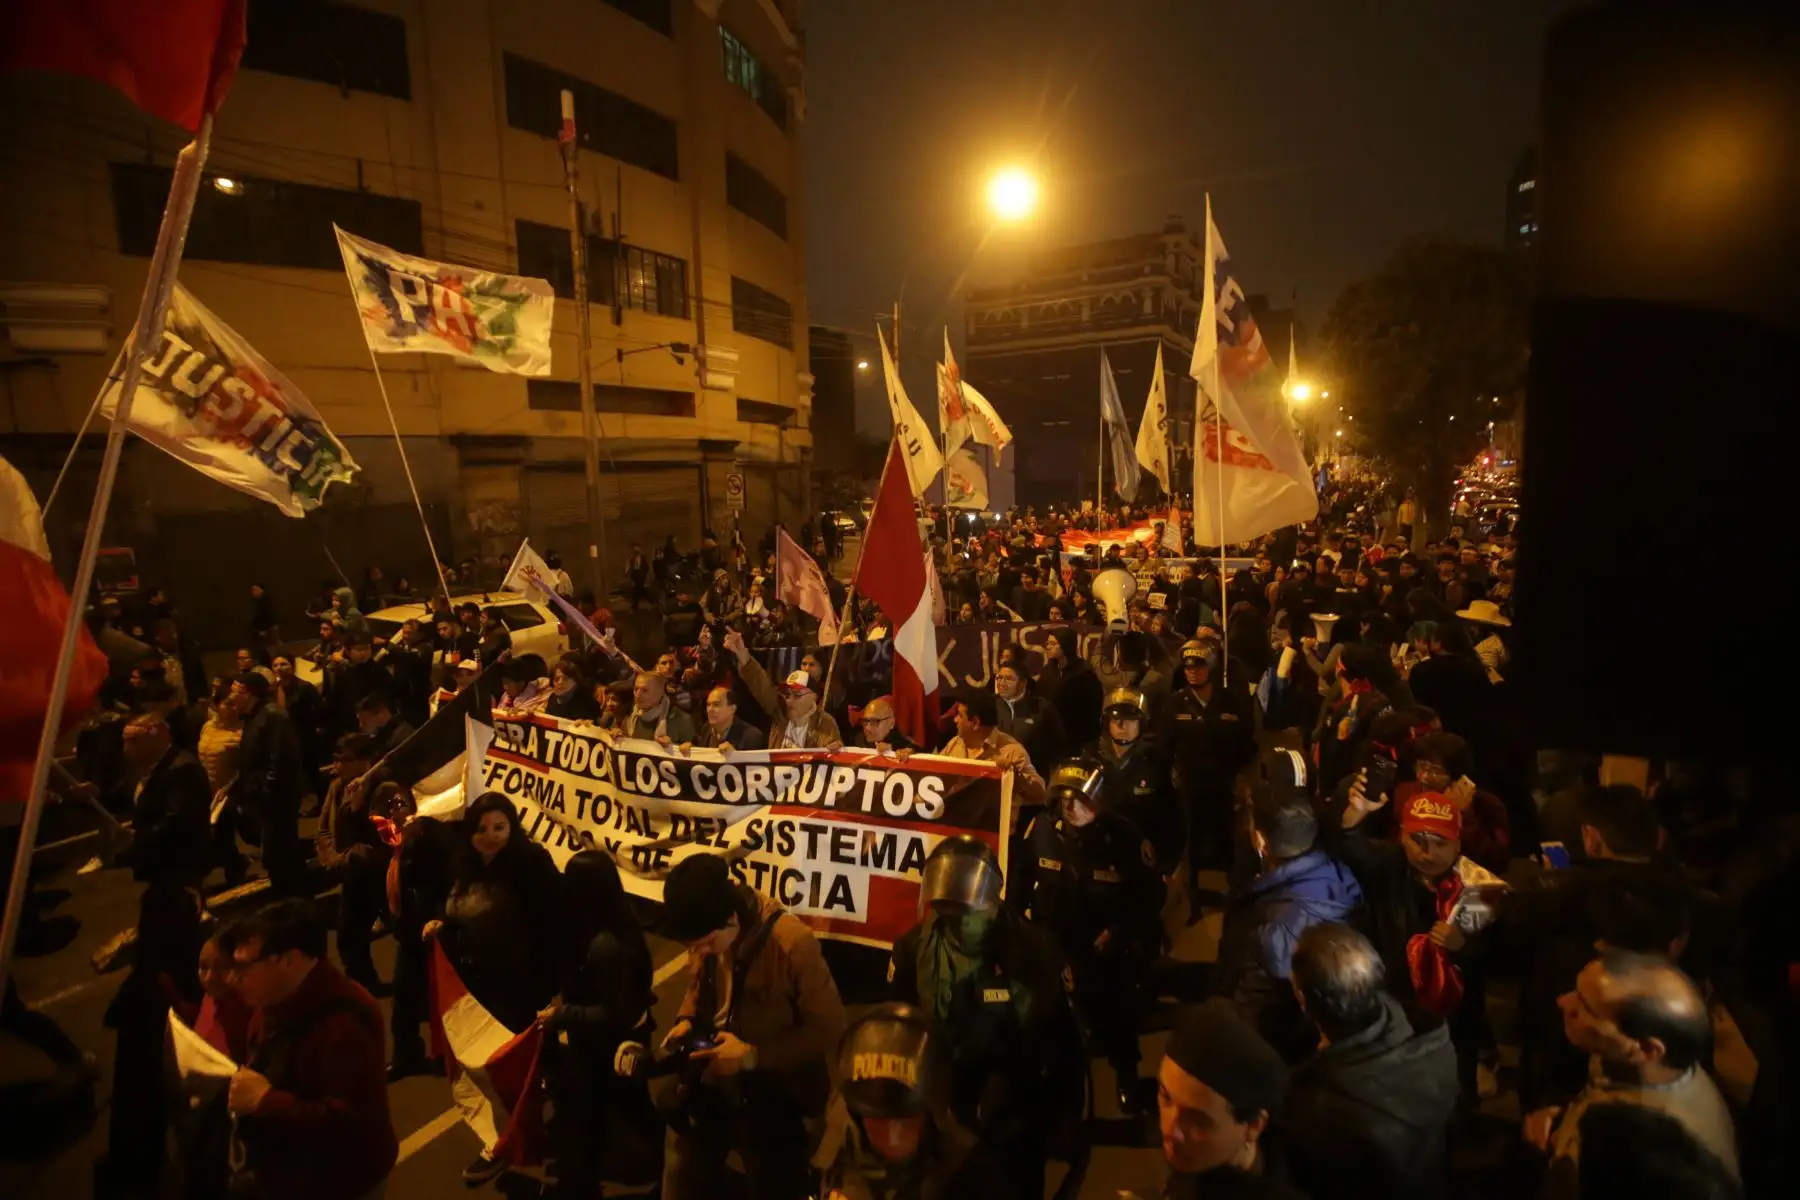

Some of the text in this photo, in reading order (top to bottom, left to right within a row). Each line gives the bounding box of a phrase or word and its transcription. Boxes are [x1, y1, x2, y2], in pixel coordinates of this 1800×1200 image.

[482, 760, 927, 877] FORMA TOTAL DEL SISTEMA
[494, 720, 538, 759] ERA
[618, 754, 682, 797] LOS
[690, 763, 945, 820] CORRUPTOS
[631, 844, 673, 873] DE
[730, 857, 856, 913] STICIA
